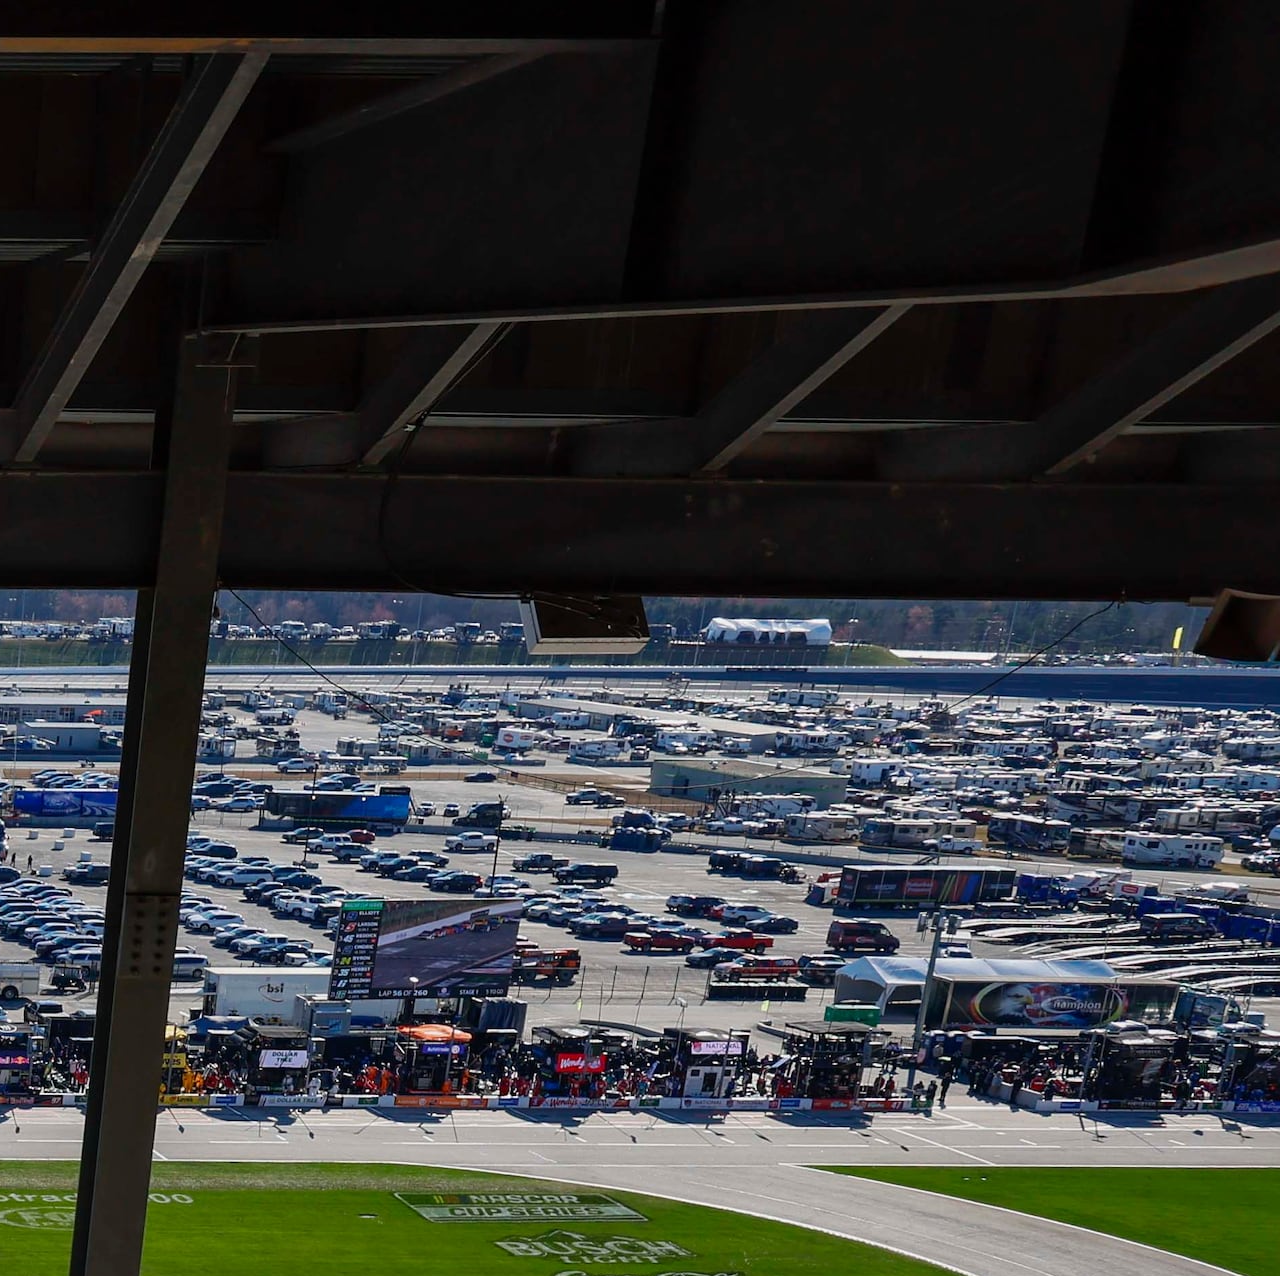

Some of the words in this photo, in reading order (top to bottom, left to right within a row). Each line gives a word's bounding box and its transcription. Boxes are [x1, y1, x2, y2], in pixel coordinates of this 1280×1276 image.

[469, 1194, 580, 1205] NASCAR
[448, 1206, 495, 1218] CUP
[498, 1206, 605, 1217] SERIES
[495, 1238, 697, 1258] BUSCH
[560, 1256, 662, 1264] LIGHT
